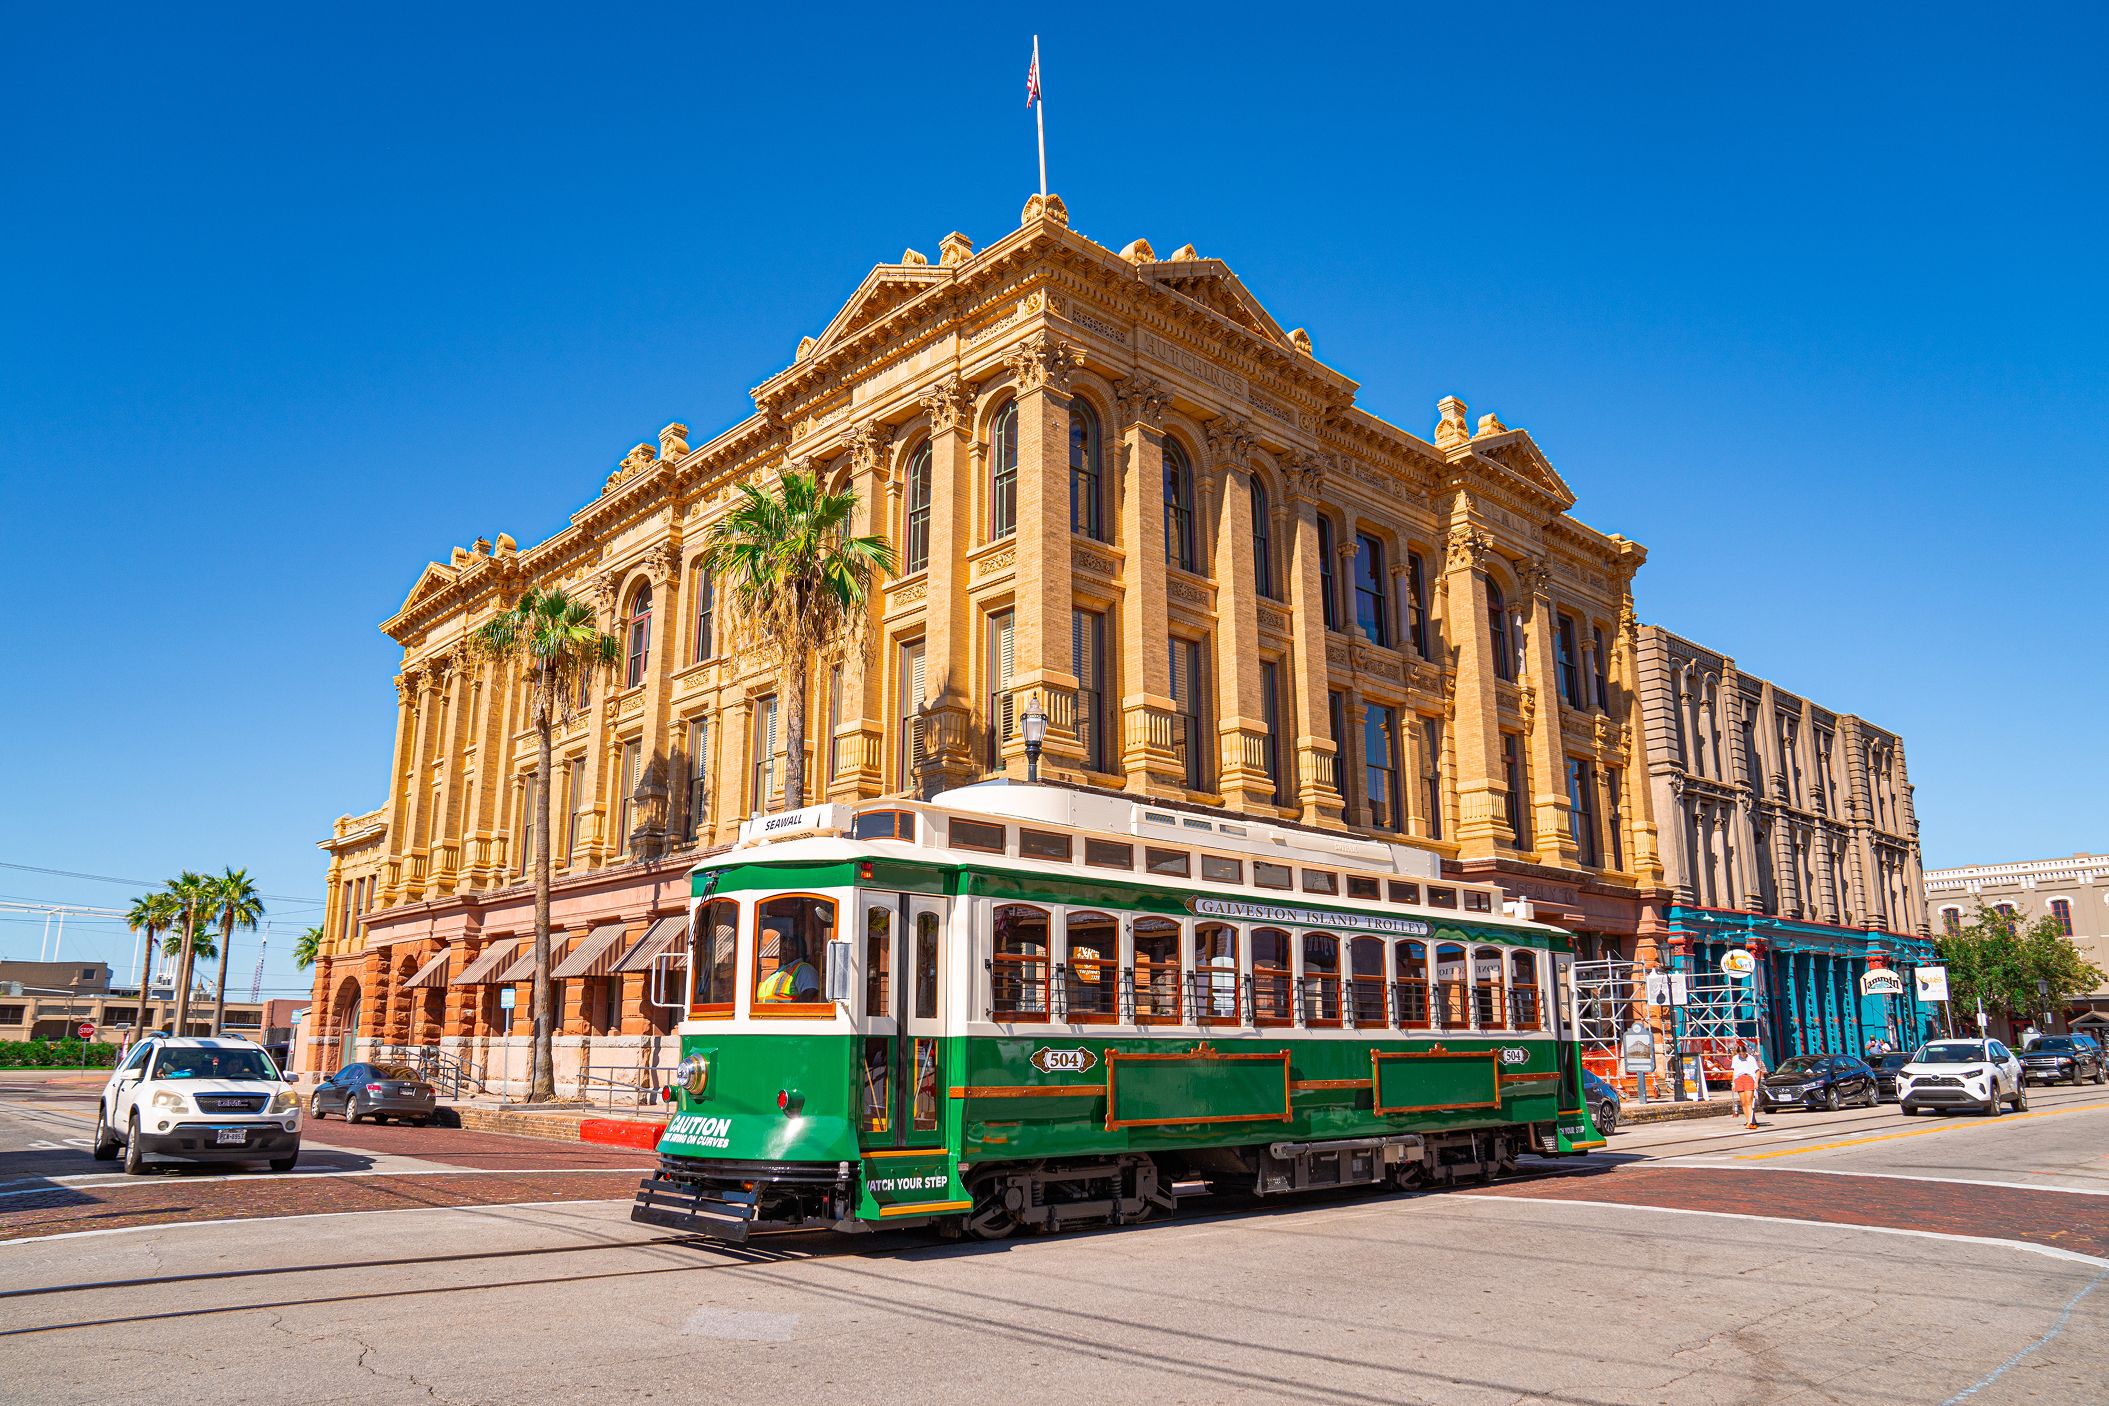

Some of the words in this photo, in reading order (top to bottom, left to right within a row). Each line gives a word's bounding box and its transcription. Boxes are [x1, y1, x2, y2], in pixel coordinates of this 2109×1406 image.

[1145, 334, 1243, 394] HUTCHINGS
[764, 814, 802, 831] SEAWALL
[1202, 900, 1297, 921] GALVESTON
[1306, 912, 1358, 926] ISLAND
[1365, 917, 1423, 933] TROLLEY
[1050, 1052, 1079, 1067] 504
[1506, 1050, 1521, 1061] 504
[669, 1115, 732, 1137] CAUTION
[696, 1135, 730, 1149] CURVES
[896, 1177, 923, 1190] YOUR
[924, 1175, 948, 1189] STEP
